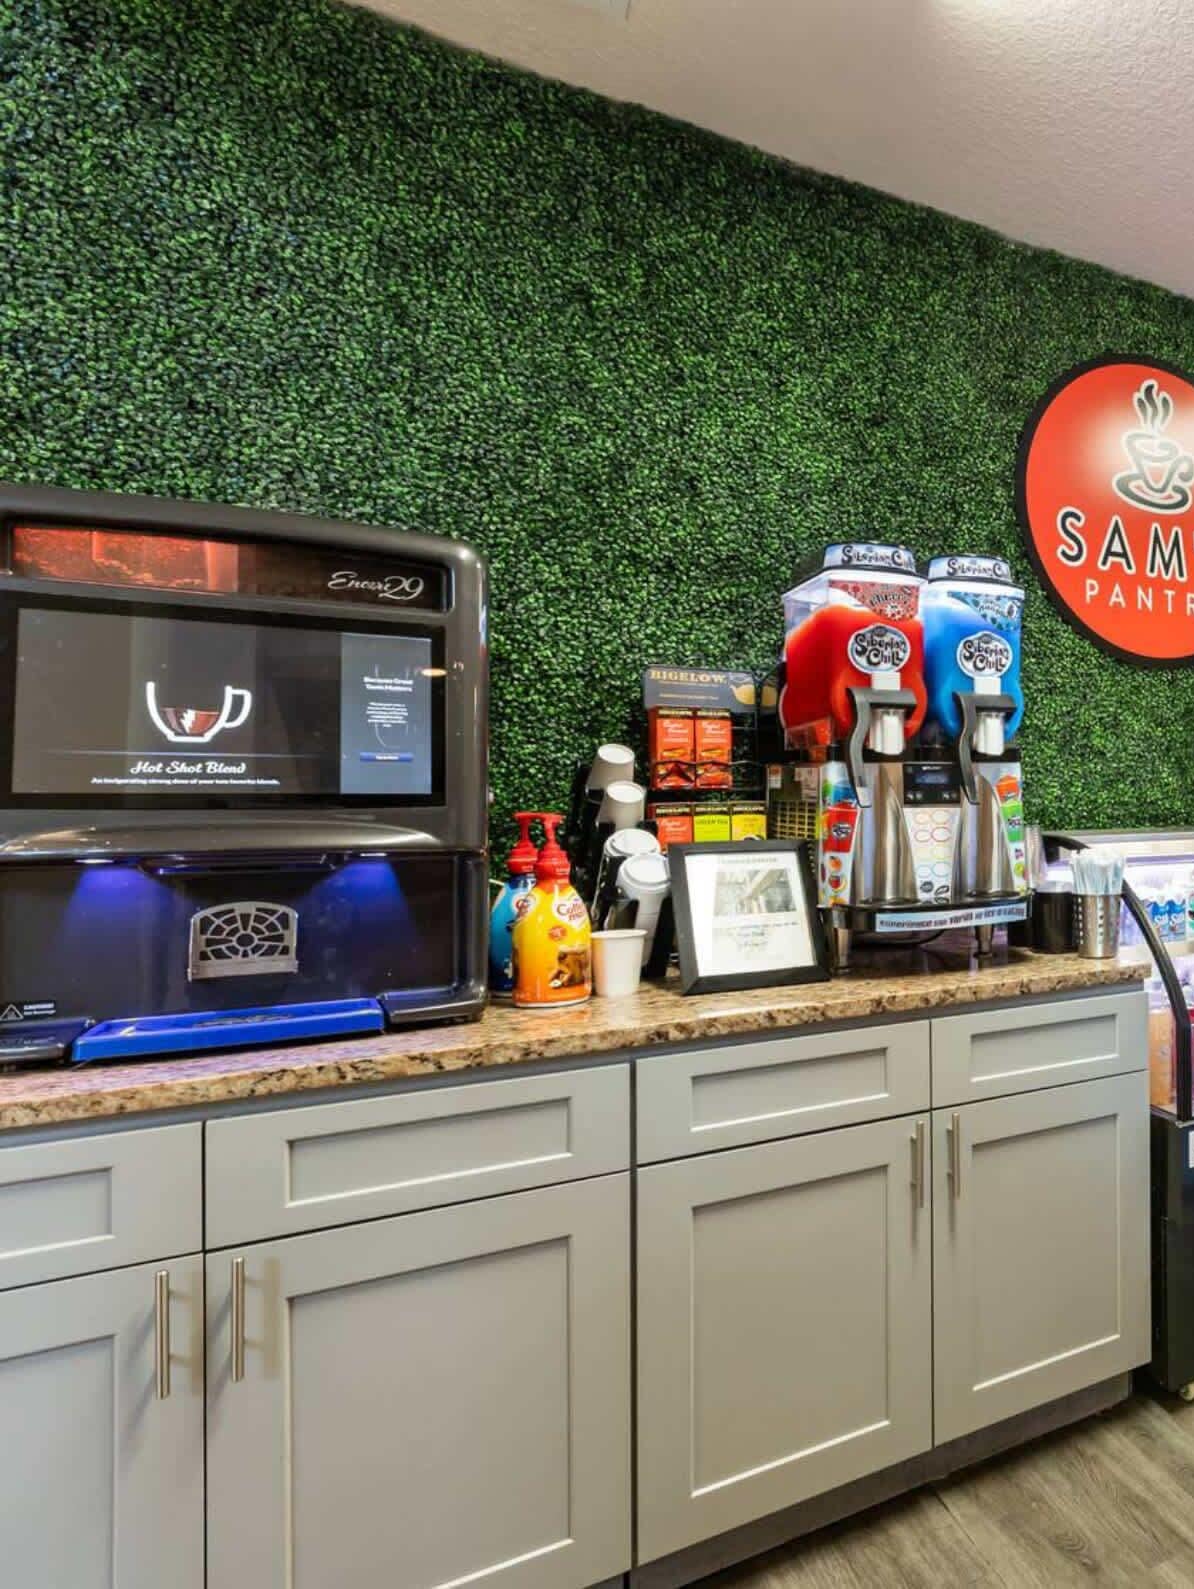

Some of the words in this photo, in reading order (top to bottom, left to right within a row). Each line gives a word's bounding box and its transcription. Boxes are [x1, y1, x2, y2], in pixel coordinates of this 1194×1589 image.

[855, 633, 906, 656] Siberian
[963, 640, 1009, 661] Siberian
[867, 648, 904, 667] Chill
[973, 653, 1006, 673] Chill
[651, 670, 726, 684] BIGELOW
[130, 760, 162, 775] Hot
[166, 760, 202, 775] Shot
[205, 761, 247, 775] Blend
